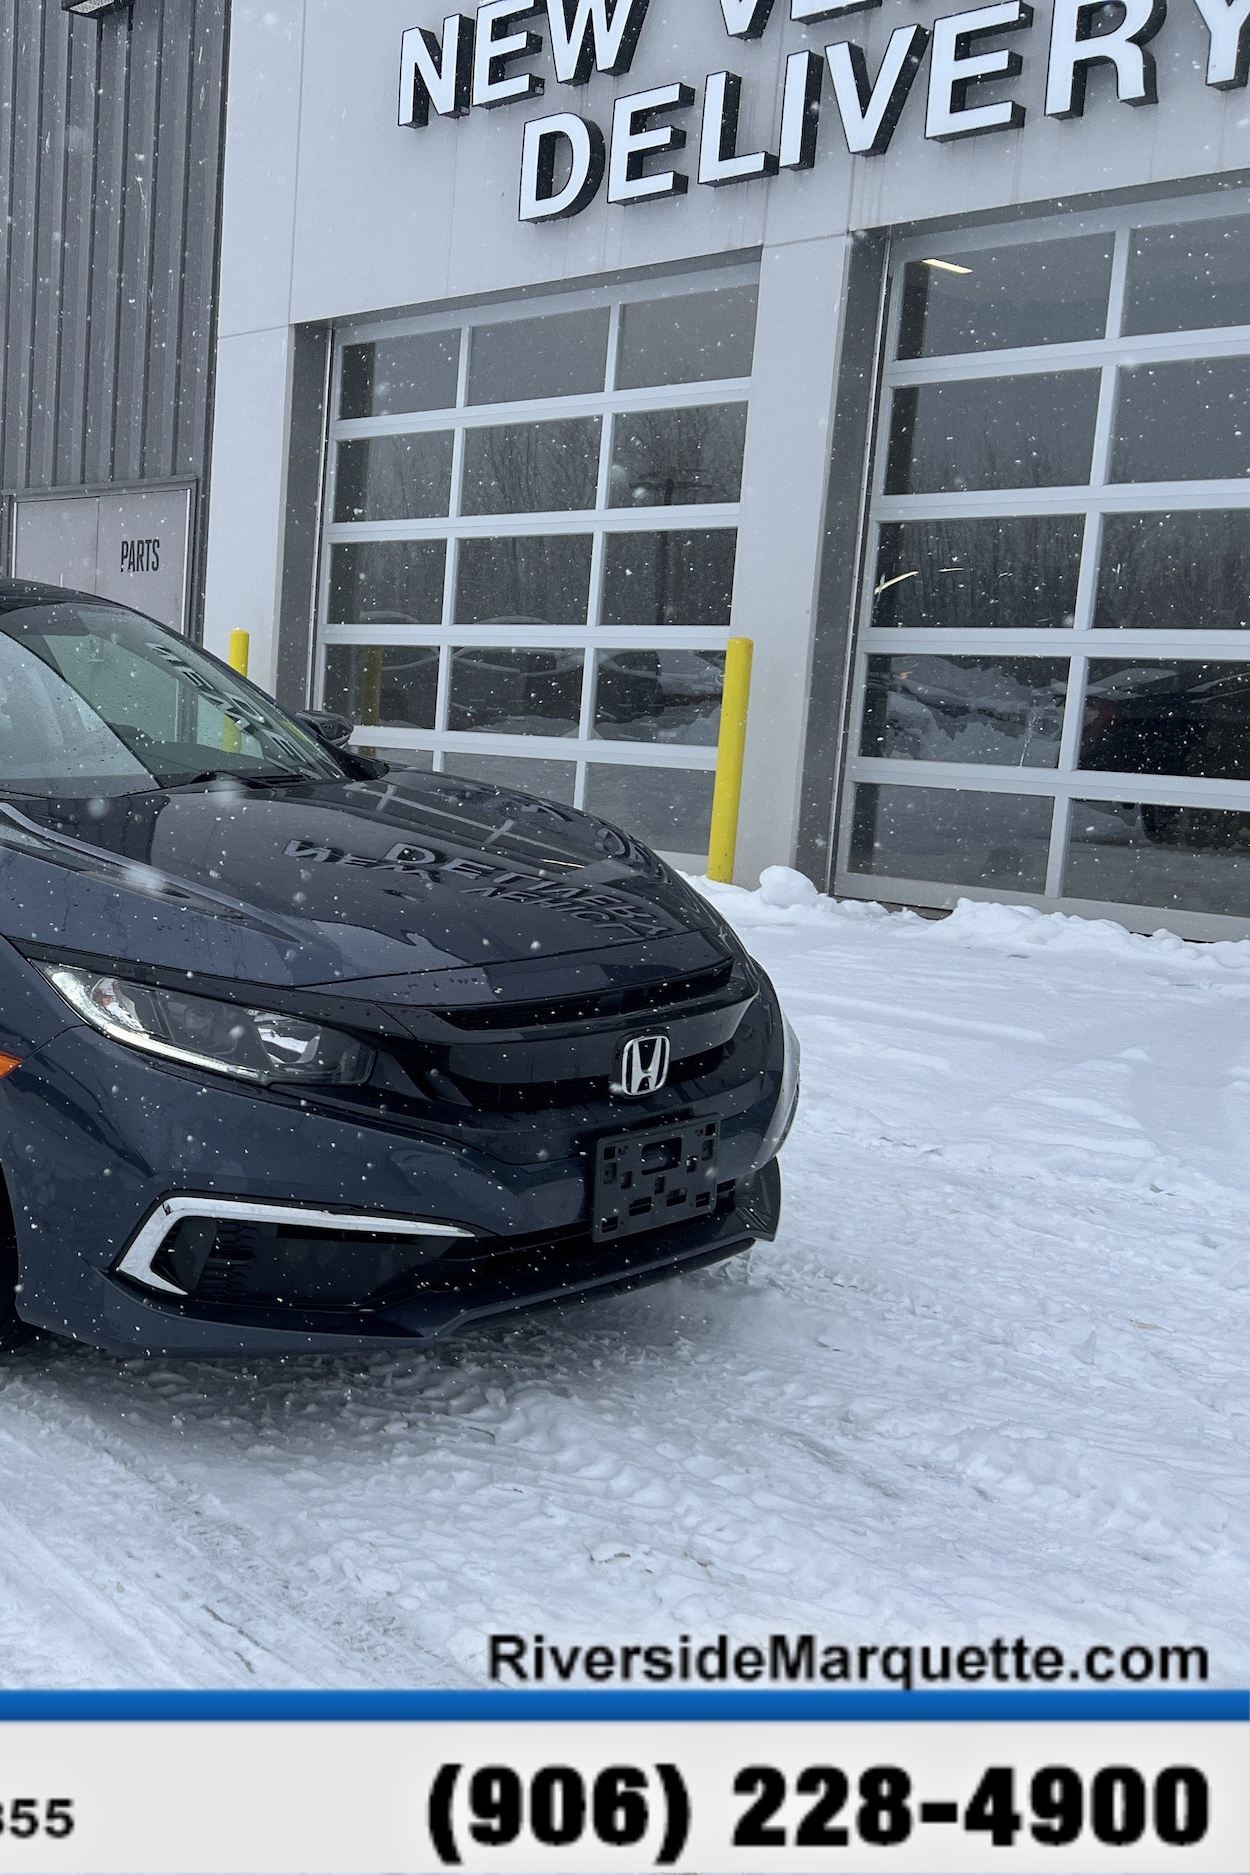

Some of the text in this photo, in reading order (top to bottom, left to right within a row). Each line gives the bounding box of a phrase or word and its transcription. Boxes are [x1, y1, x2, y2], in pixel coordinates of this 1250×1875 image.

[397, 0, 650, 129] NEW
[517, 0, 1250, 225] DELIVERY
[120, 538, 161, 573] PARTS
